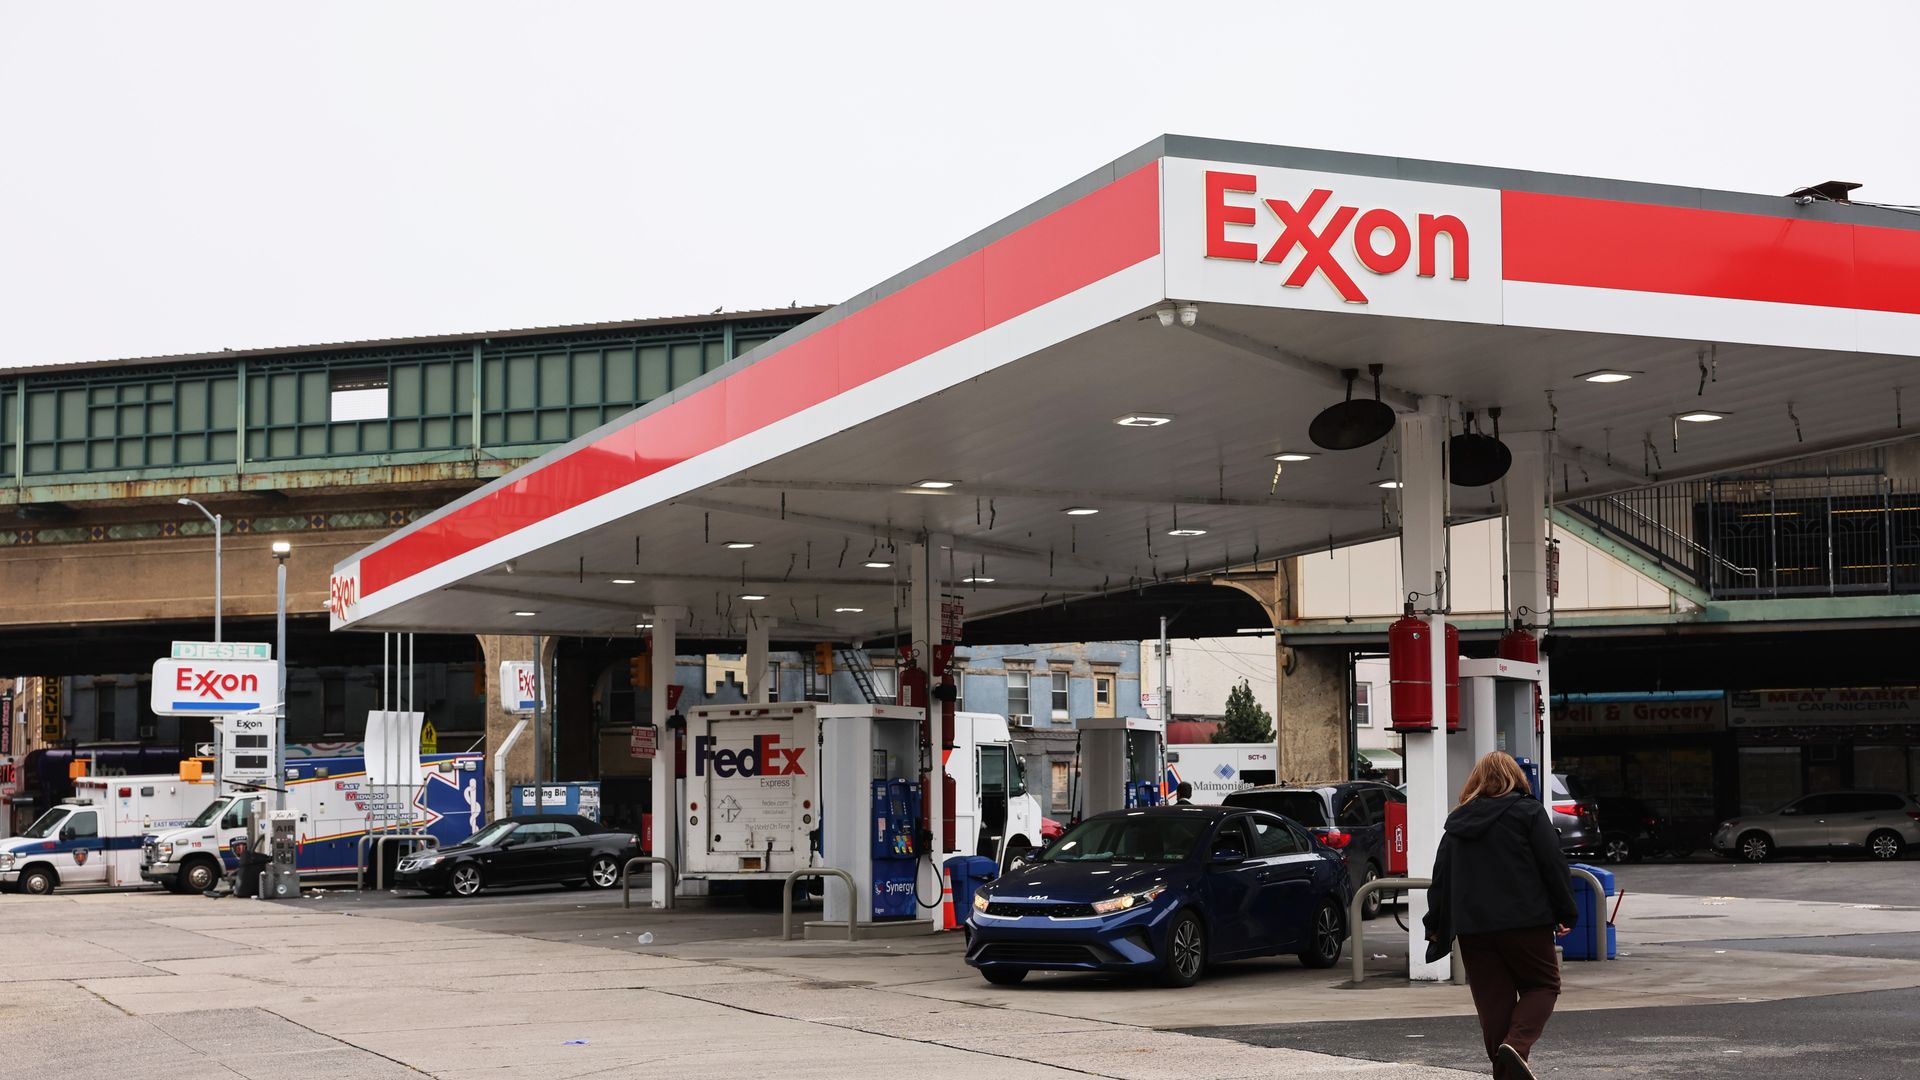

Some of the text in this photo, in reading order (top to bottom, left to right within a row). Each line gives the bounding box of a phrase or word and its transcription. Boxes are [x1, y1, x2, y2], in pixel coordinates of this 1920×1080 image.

[1203, 170, 1470, 305] Exxon
[331, 576, 356, 622] Exxon
[179, 644, 263, 658] DIESEL
[176, 668, 258, 699] Exxon
[518, 669, 535, 698] Exxo
[1767, 691, 1825, 703] MEAT
[1553, 704, 1714, 722] Deli & Grocery
[1797, 701, 1910, 712] CARNICERIA
[236, 720, 262, 730] Exxon
[695, 734, 806, 778] FedEx
[760, 778, 790, 789] Express
[1193, 780, 1255, 791] Maimonides
[555, 788, 566, 797] Bin
[886, 881, 914, 895] Synergy
